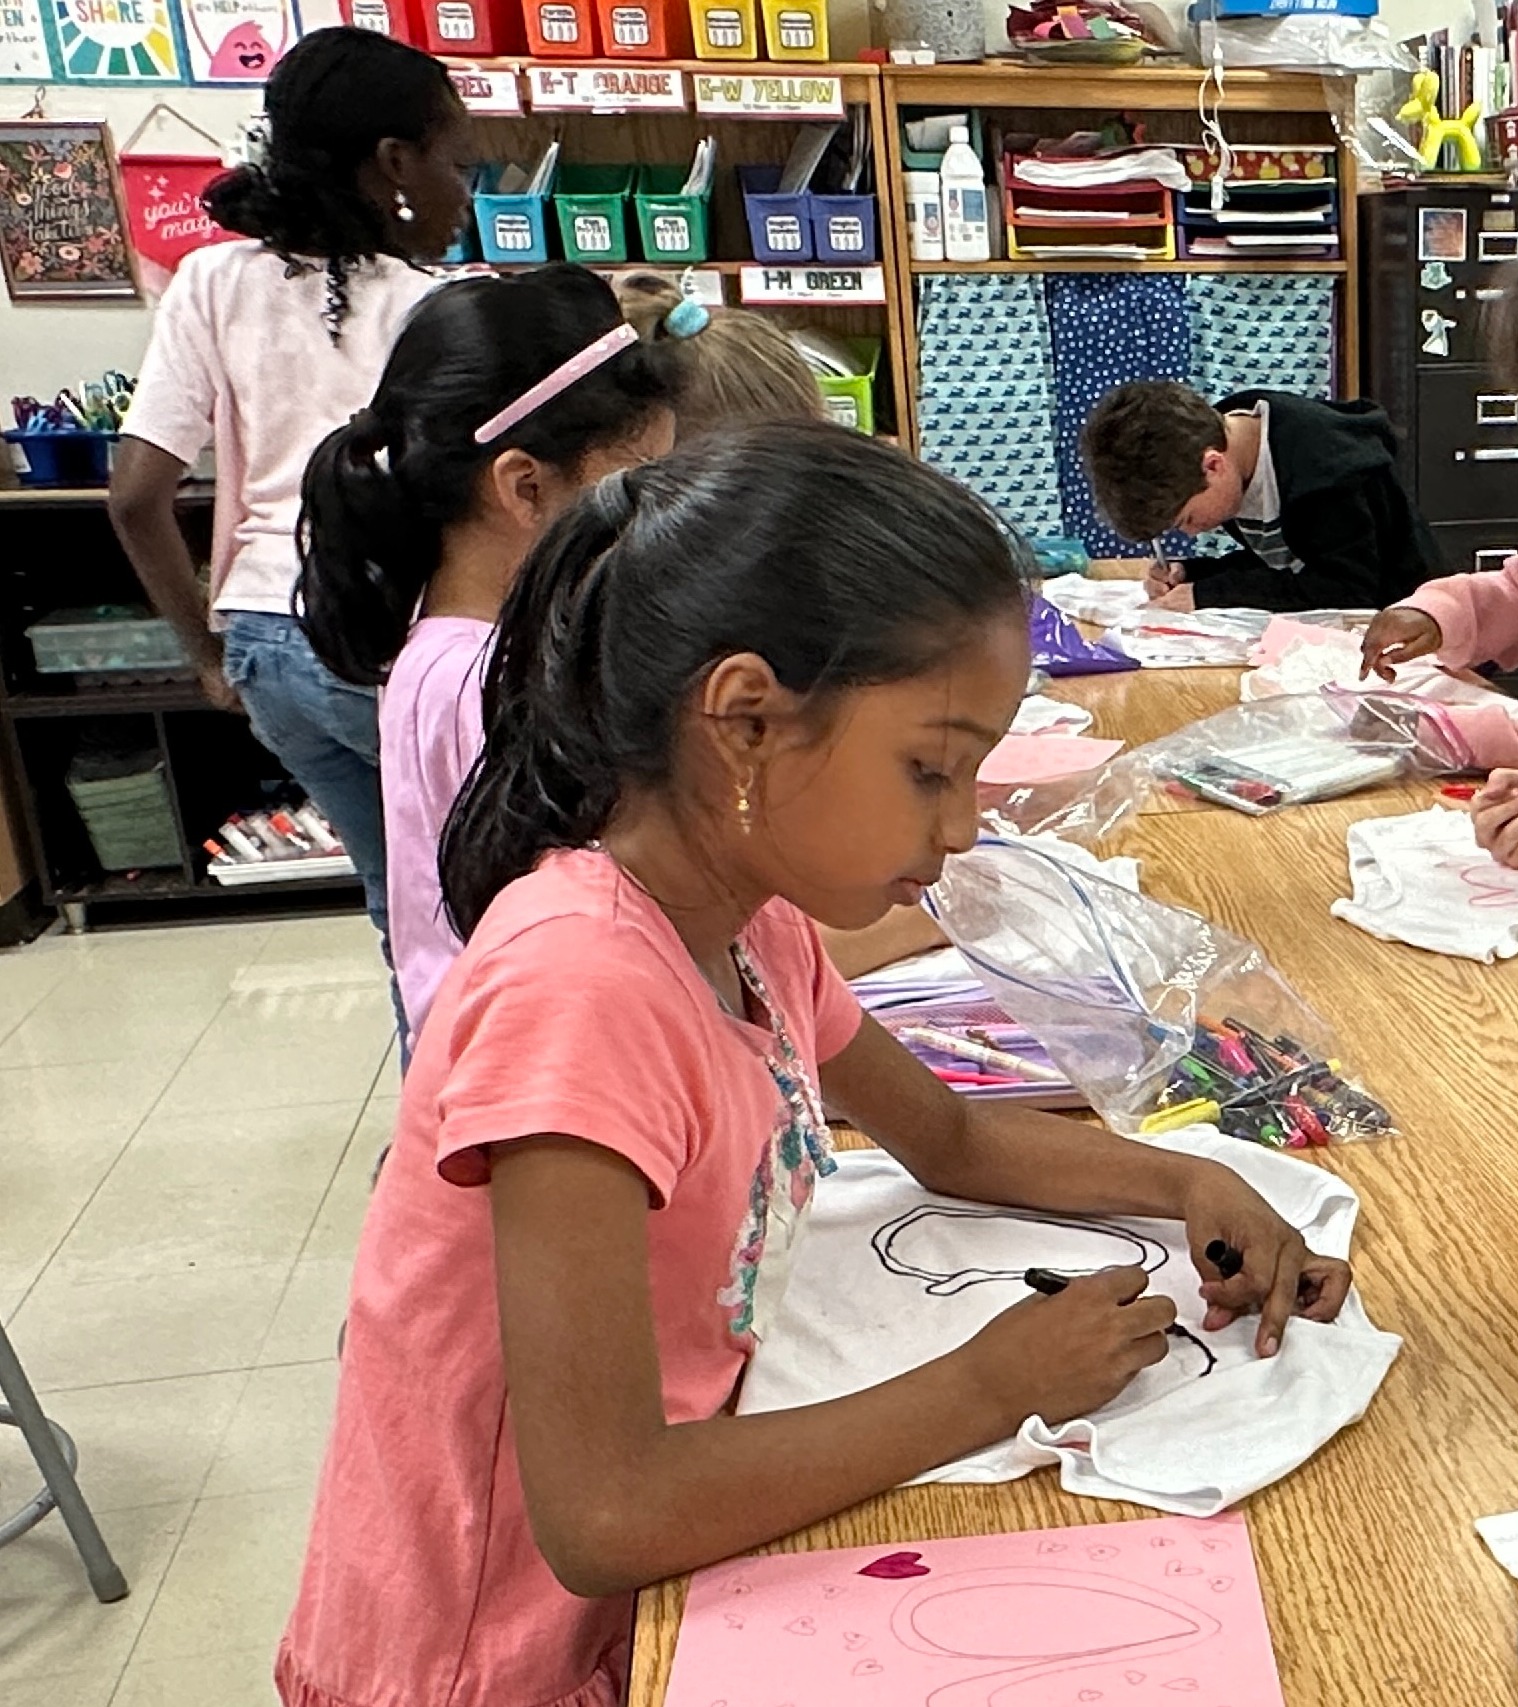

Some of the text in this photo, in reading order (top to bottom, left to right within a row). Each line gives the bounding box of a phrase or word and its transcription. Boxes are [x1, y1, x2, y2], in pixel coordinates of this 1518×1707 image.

[593, 72, 672, 96] ORANGE
[752, 79, 834, 103] YELLOW
[806, 271, 862, 291] GREEN
